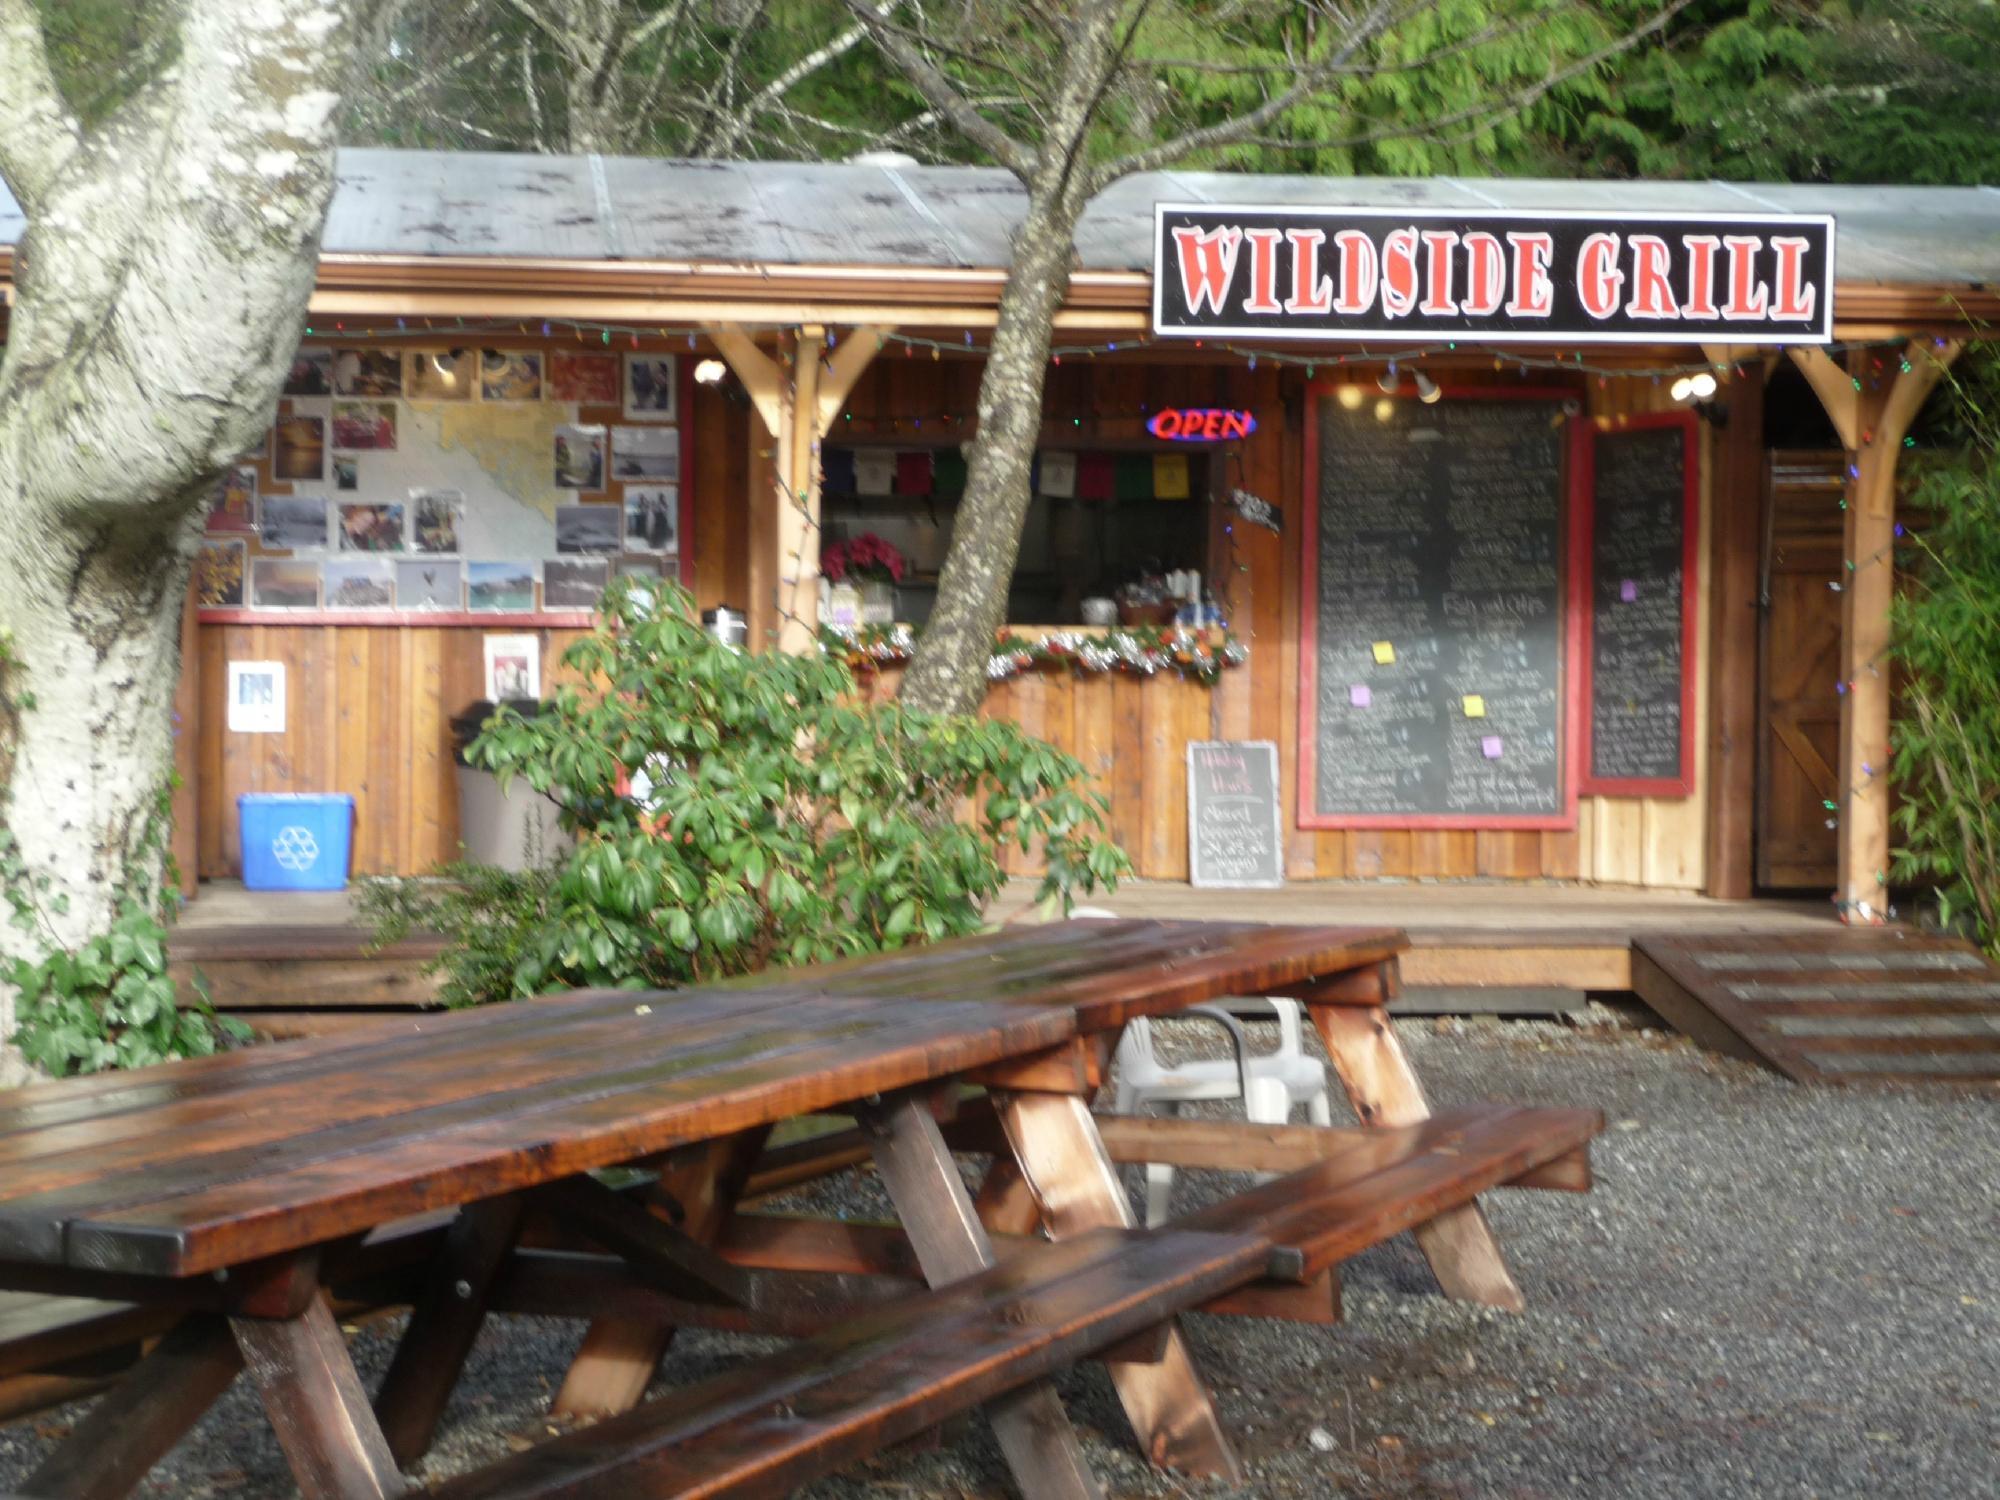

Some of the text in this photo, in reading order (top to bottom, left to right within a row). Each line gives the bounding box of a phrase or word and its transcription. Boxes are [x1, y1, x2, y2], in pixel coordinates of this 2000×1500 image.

[1172, 225, 1816, 322] WILDSIDE GRILL
[1155, 407, 1252, 439] OPEN
